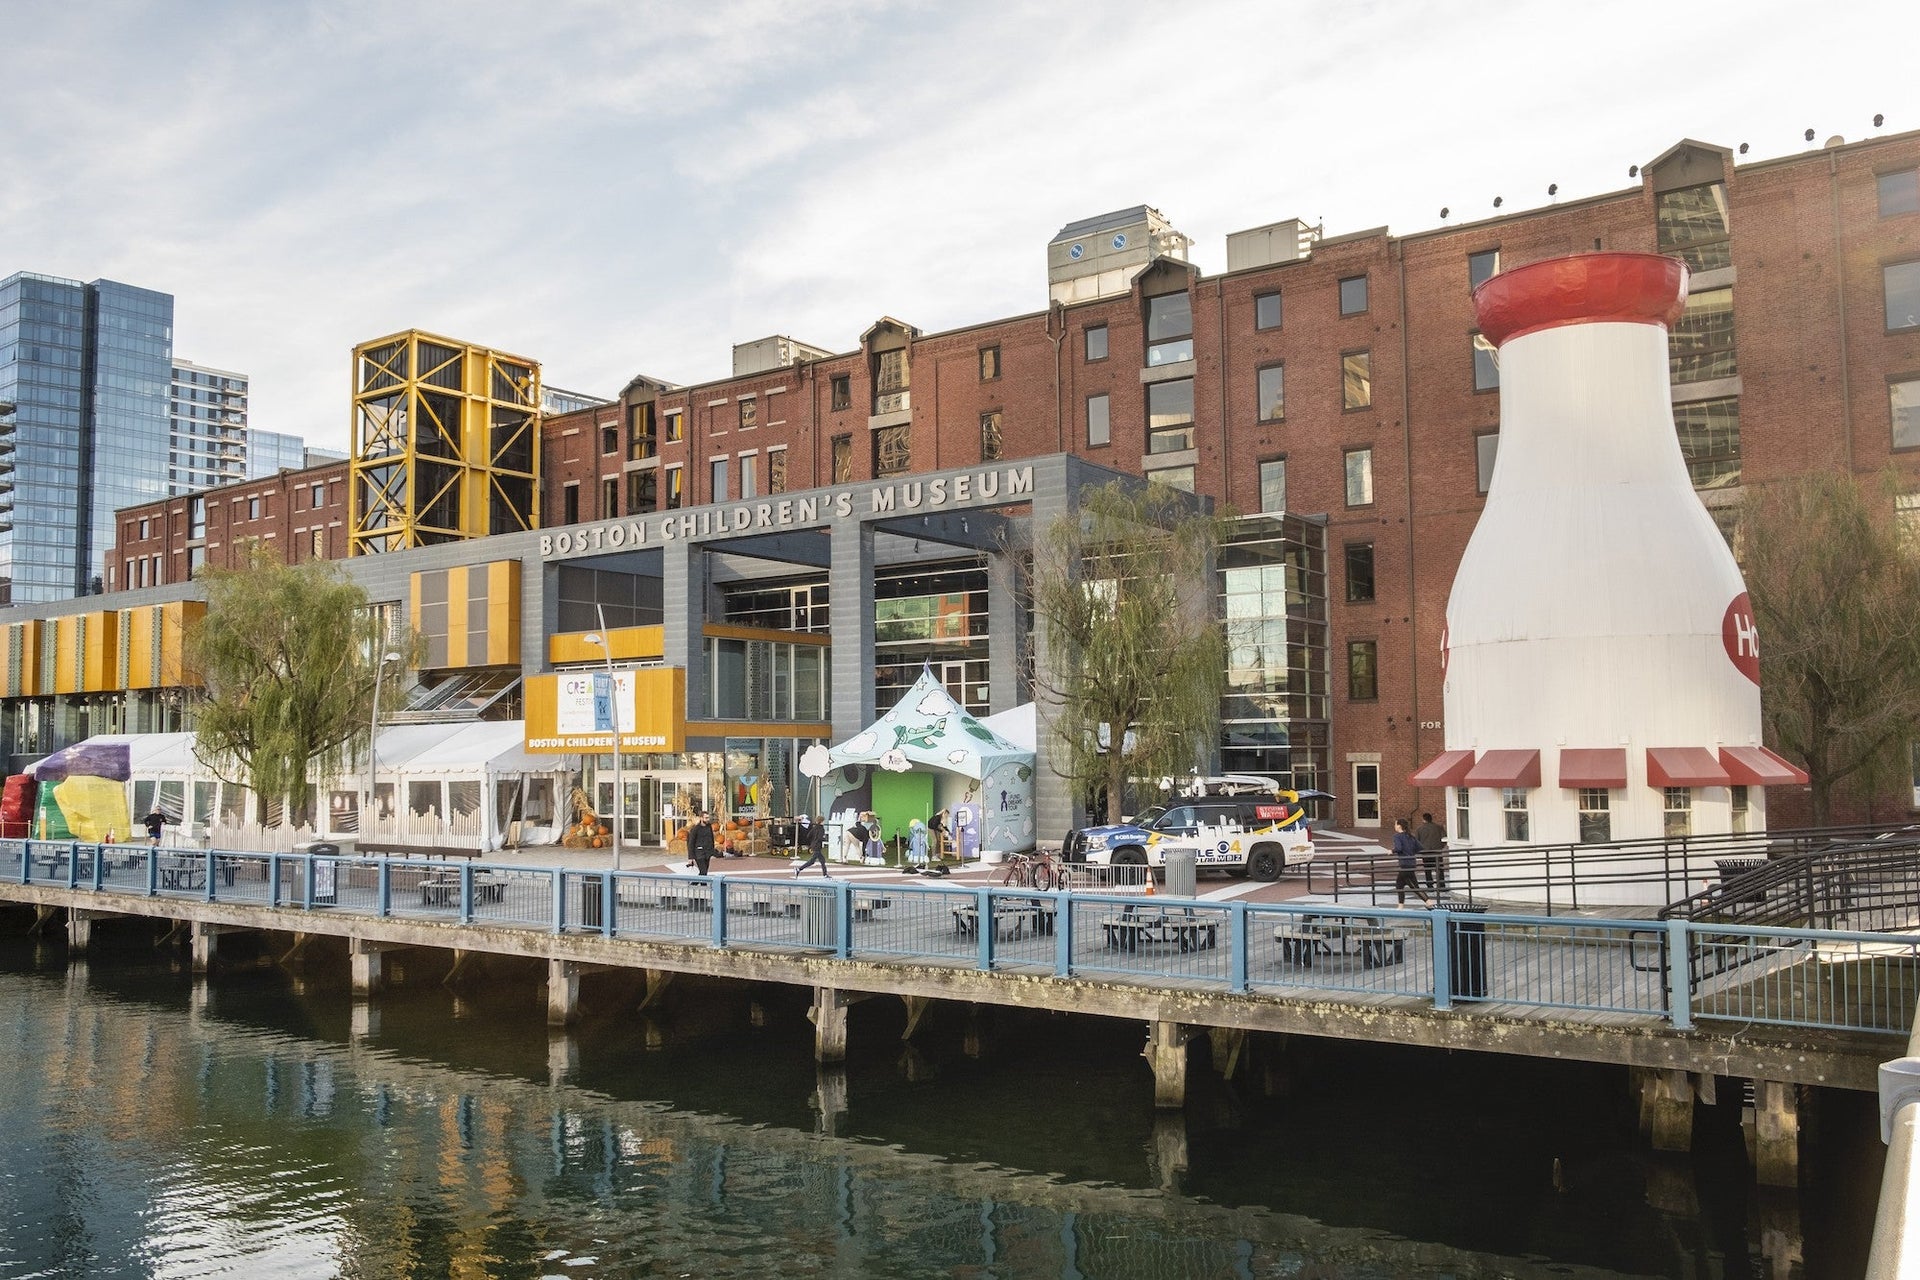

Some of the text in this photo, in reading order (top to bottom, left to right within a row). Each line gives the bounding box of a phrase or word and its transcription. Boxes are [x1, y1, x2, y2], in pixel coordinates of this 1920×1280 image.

[540, 466, 1034, 556] BOSTON CHILDREN'S MUSEUM
[1421, 721, 1441, 729] FOR
[529, 737, 565, 748] BOSTON
[623, 735, 666, 746] MUSEUM
[1230, 839, 1242, 853] 4
[1217, 854, 1242, 863] WBZ
